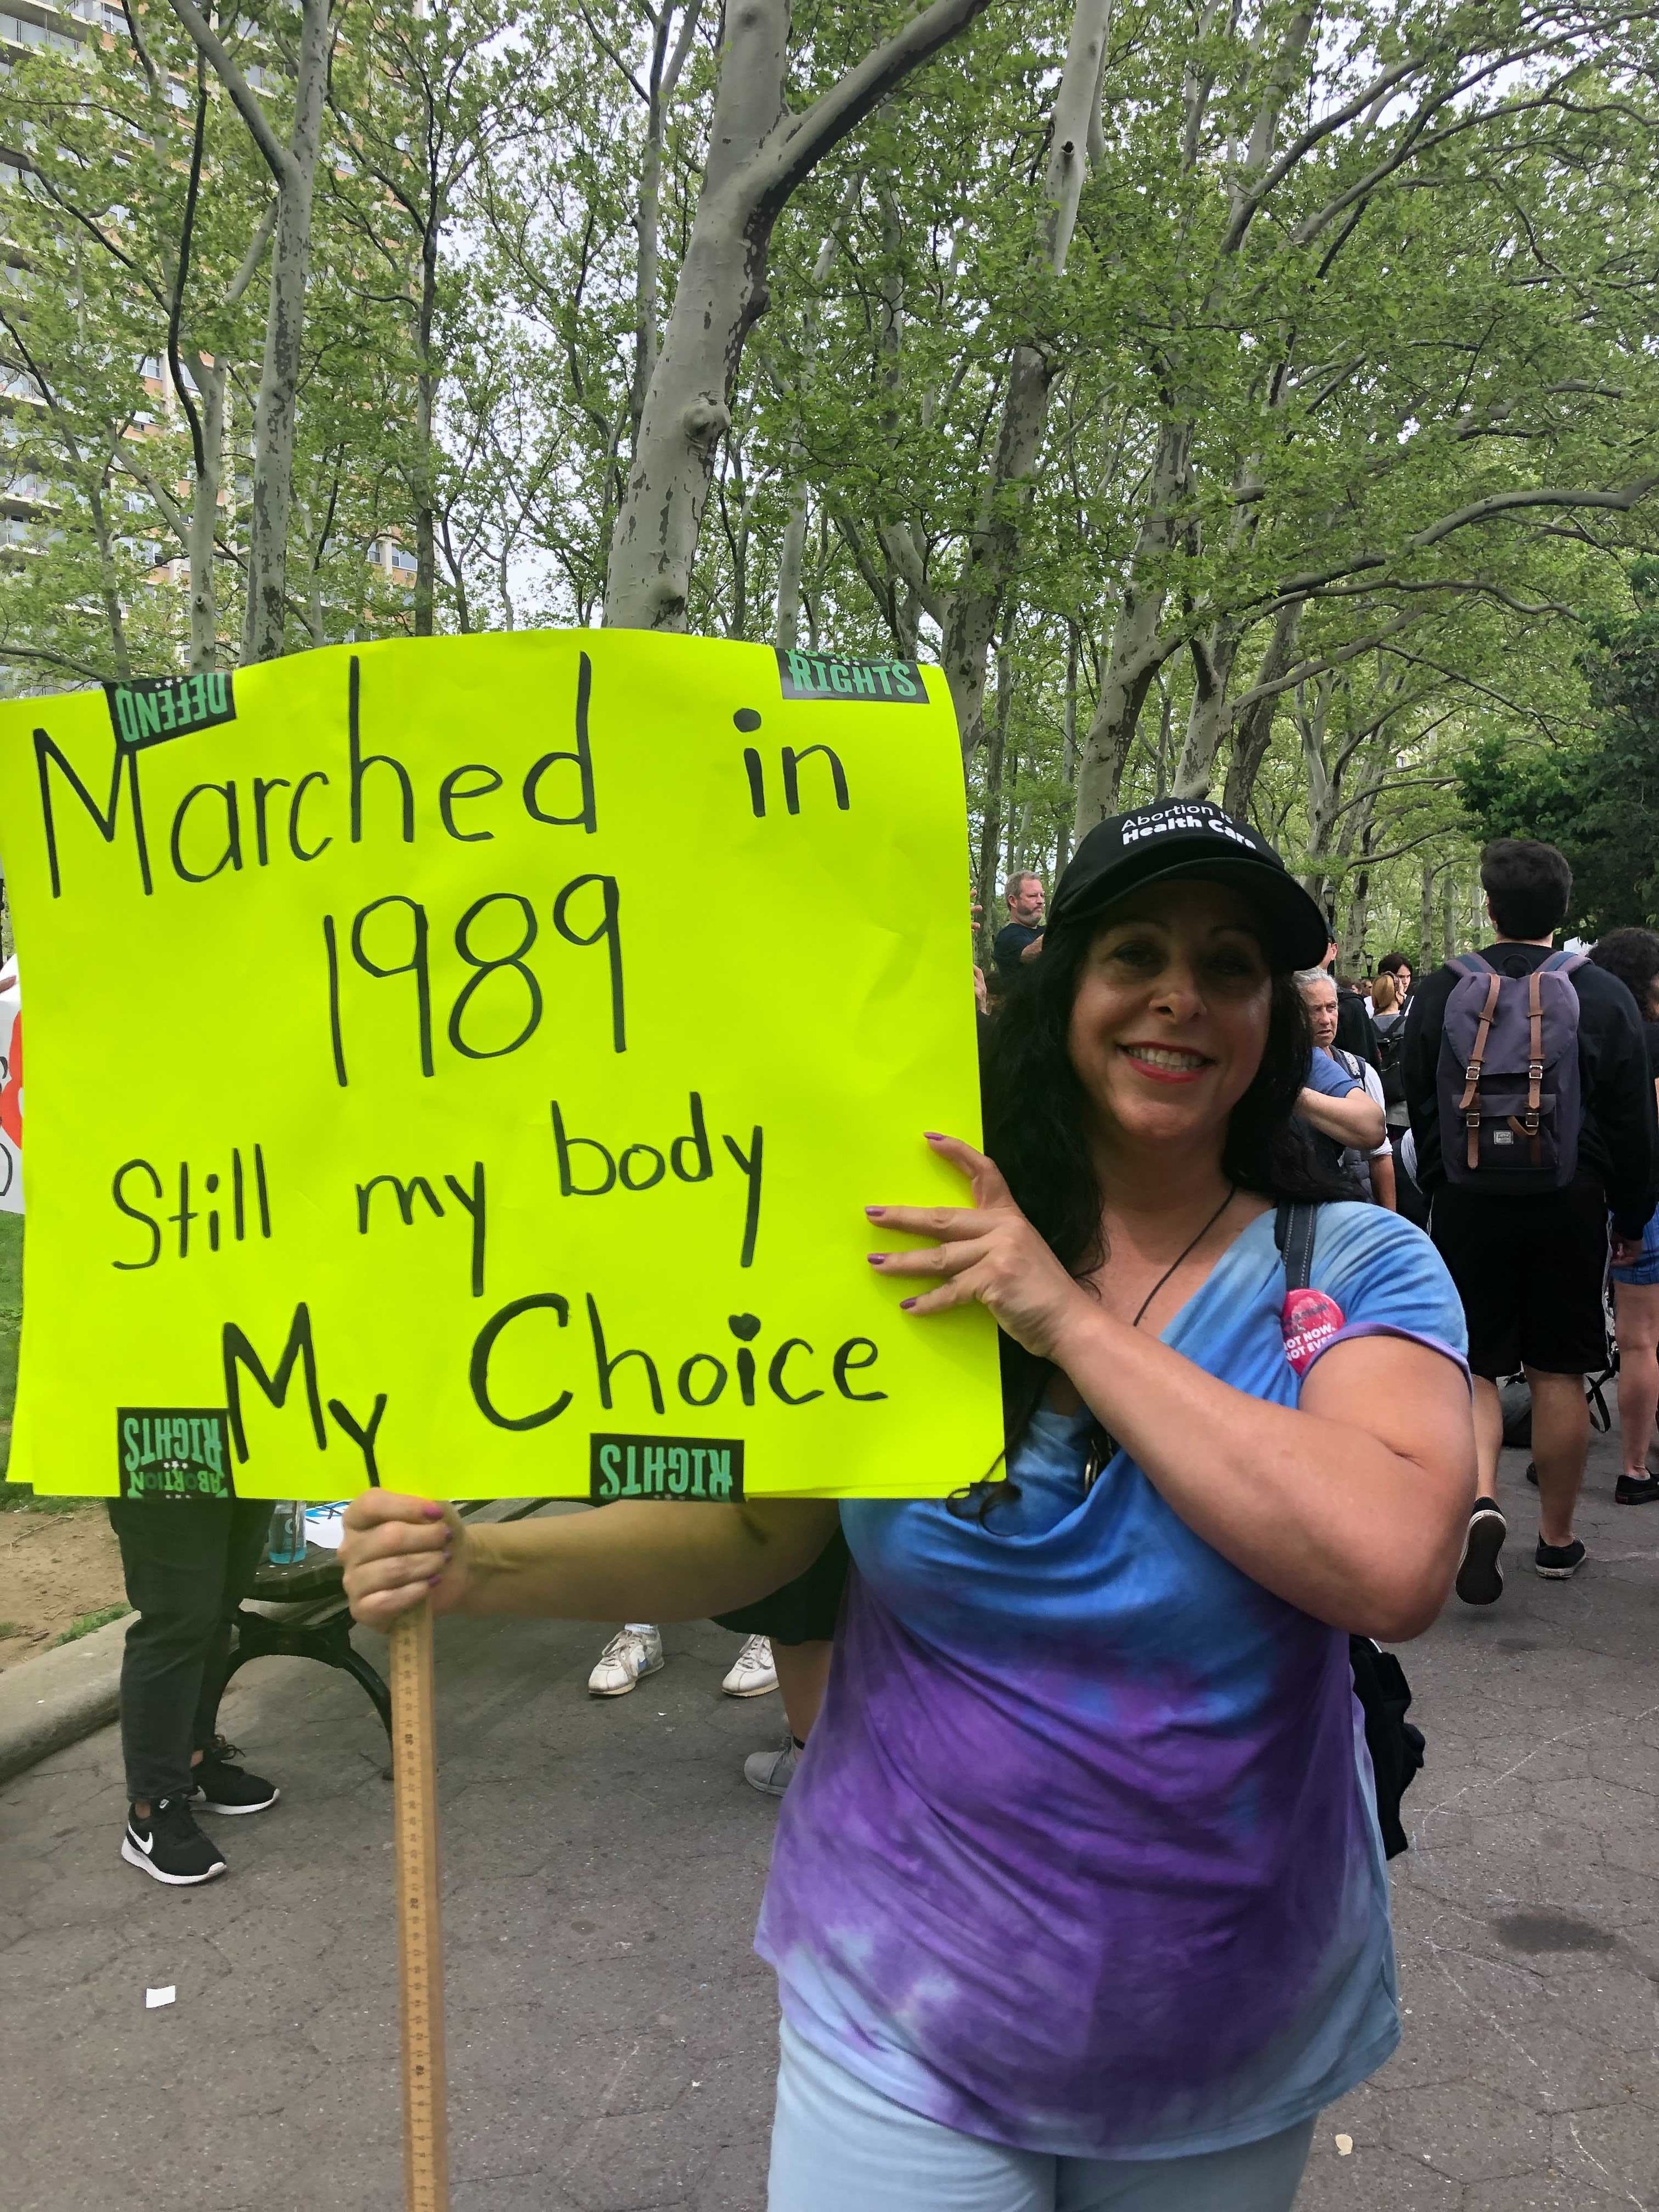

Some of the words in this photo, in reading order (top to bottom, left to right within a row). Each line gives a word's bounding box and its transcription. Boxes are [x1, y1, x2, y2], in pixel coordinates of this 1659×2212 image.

[785, 649, 917, 697] RIGHTS
[114, 672, 228, 742] DEFEND
[33, 651, 597, 898] Marched
[734, 708, 850, 818] in
[1120, 804, 1214, 832] Abortion
[1122, 815, 1203, 846] Health
[1208, 819, 1256, 849] Care
[324, 874, 627, 1087] 1989
[113, 1144, 271, 1270] Still
[356, 1162, 486, 1297] my
[552, 1092, 763, 1267] body
[222, 1302, 387, 1488] My
[470, 1293, 888, 1431] Choice
[124, 1417, 225, 1478] RIGHTS
[599, 1444, 733, 1502] RIGHTS
[129, 1468, 222, 1494] ABORTION
